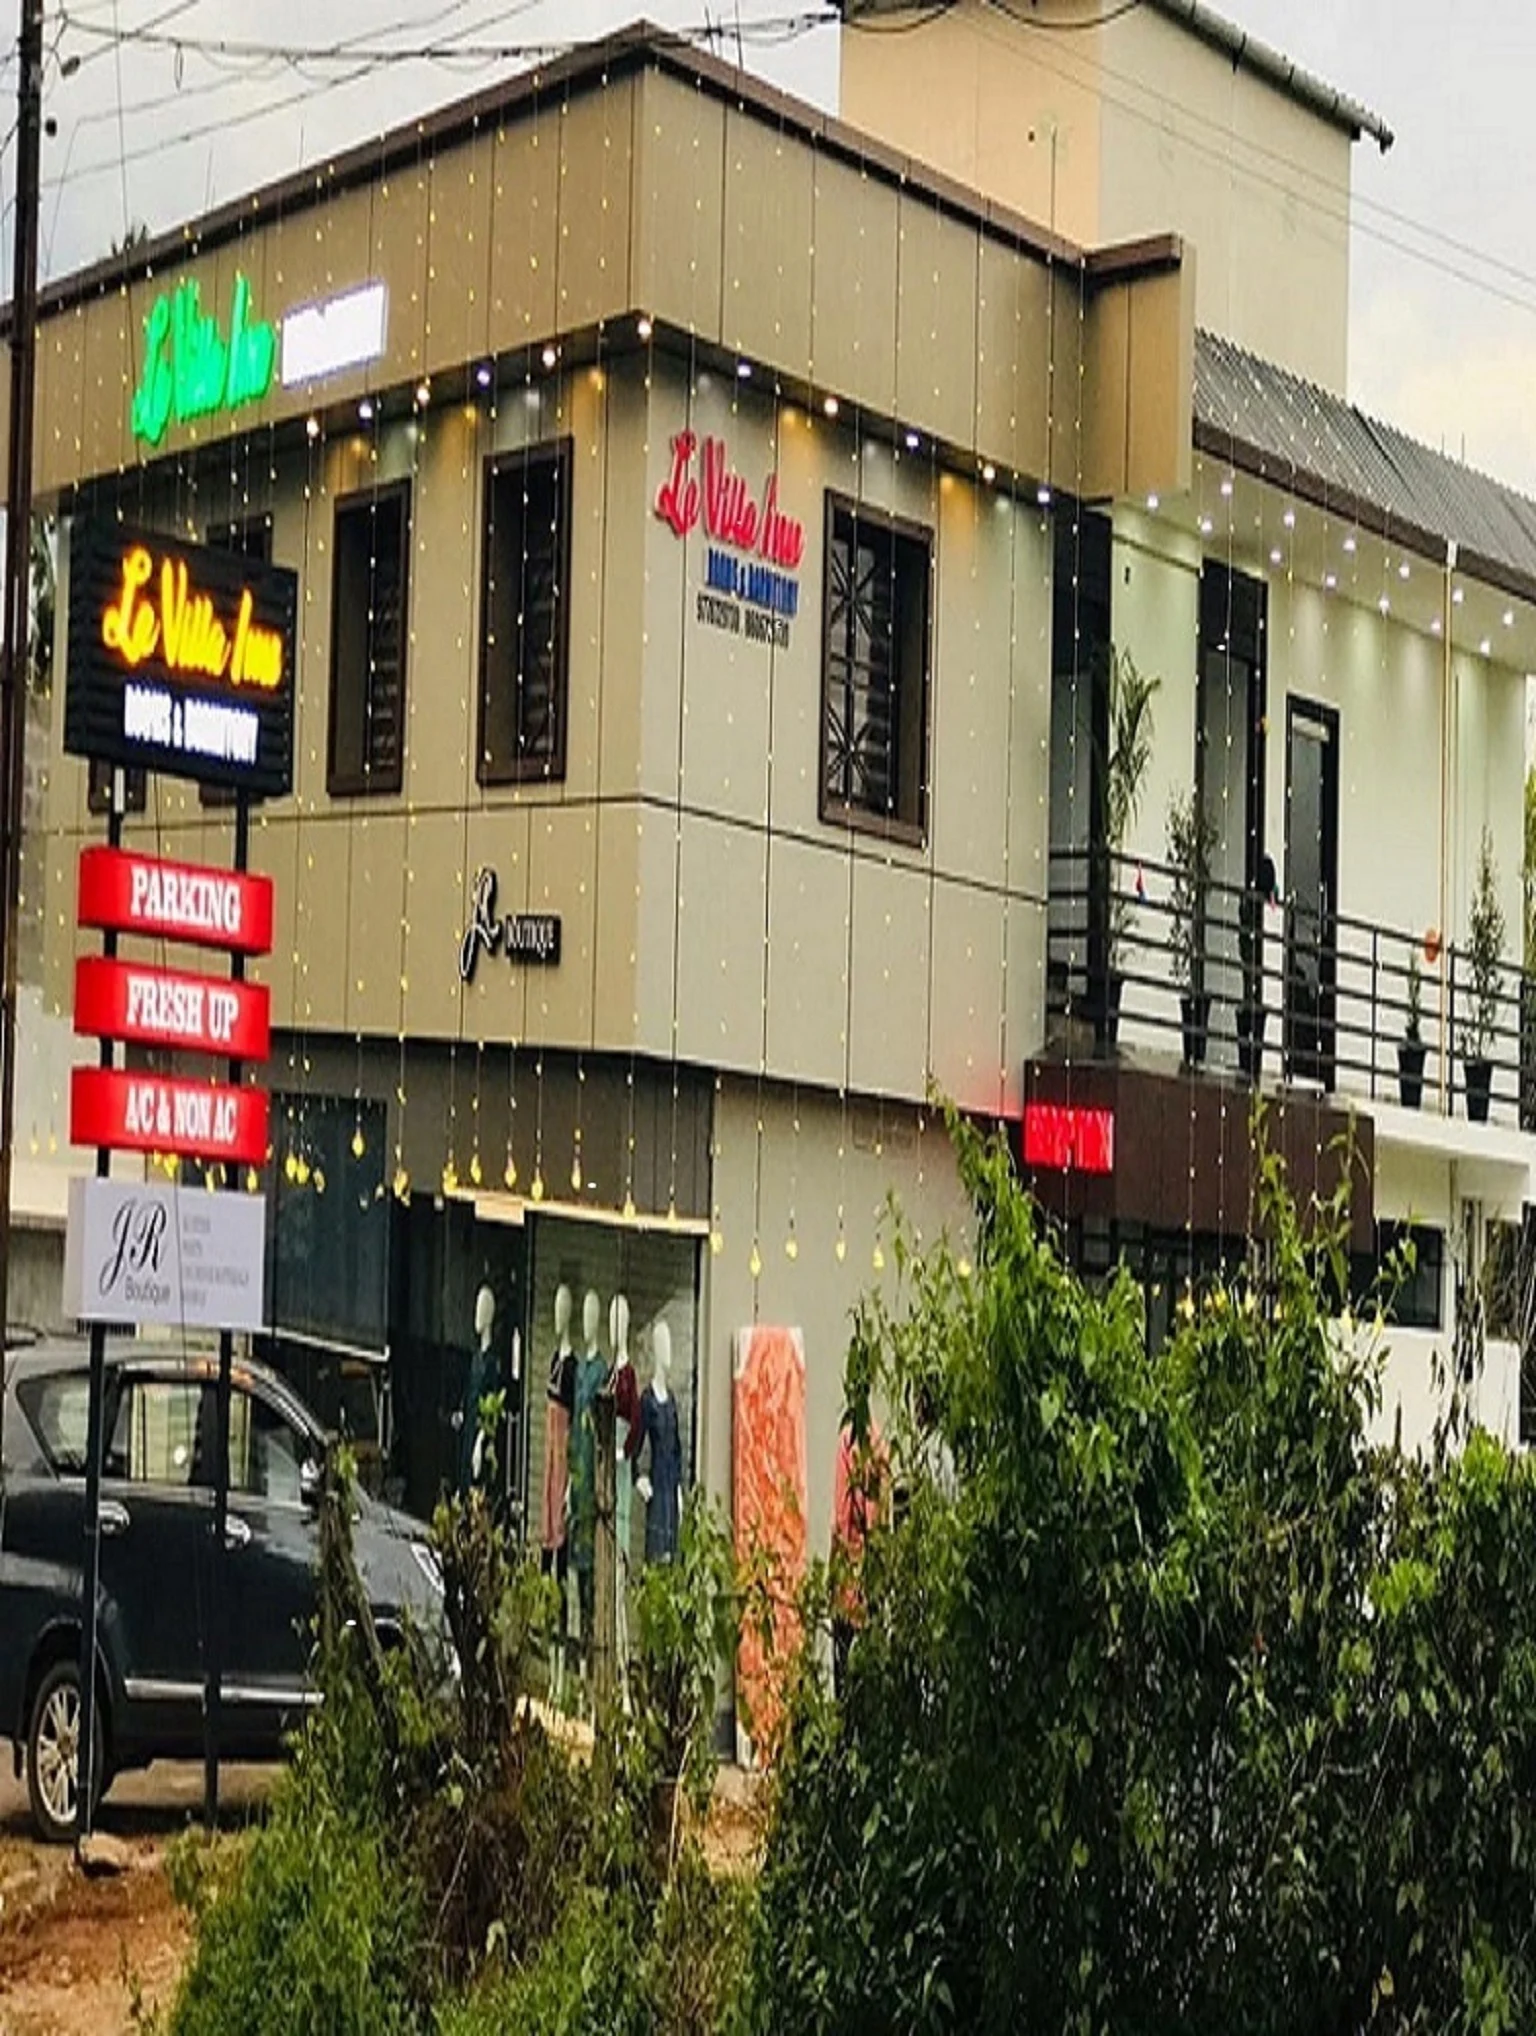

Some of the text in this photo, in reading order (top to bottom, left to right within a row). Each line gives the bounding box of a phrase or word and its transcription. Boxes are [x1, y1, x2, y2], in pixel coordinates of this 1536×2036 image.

[130, 864, 242, 934] PARKING
[126, 975, 239, 1042] FRESH UP
[157, 1087, 171, 1136] &
[173, 1090, 211, 1141] NON
[213, 1096, 238, 1144] AC
